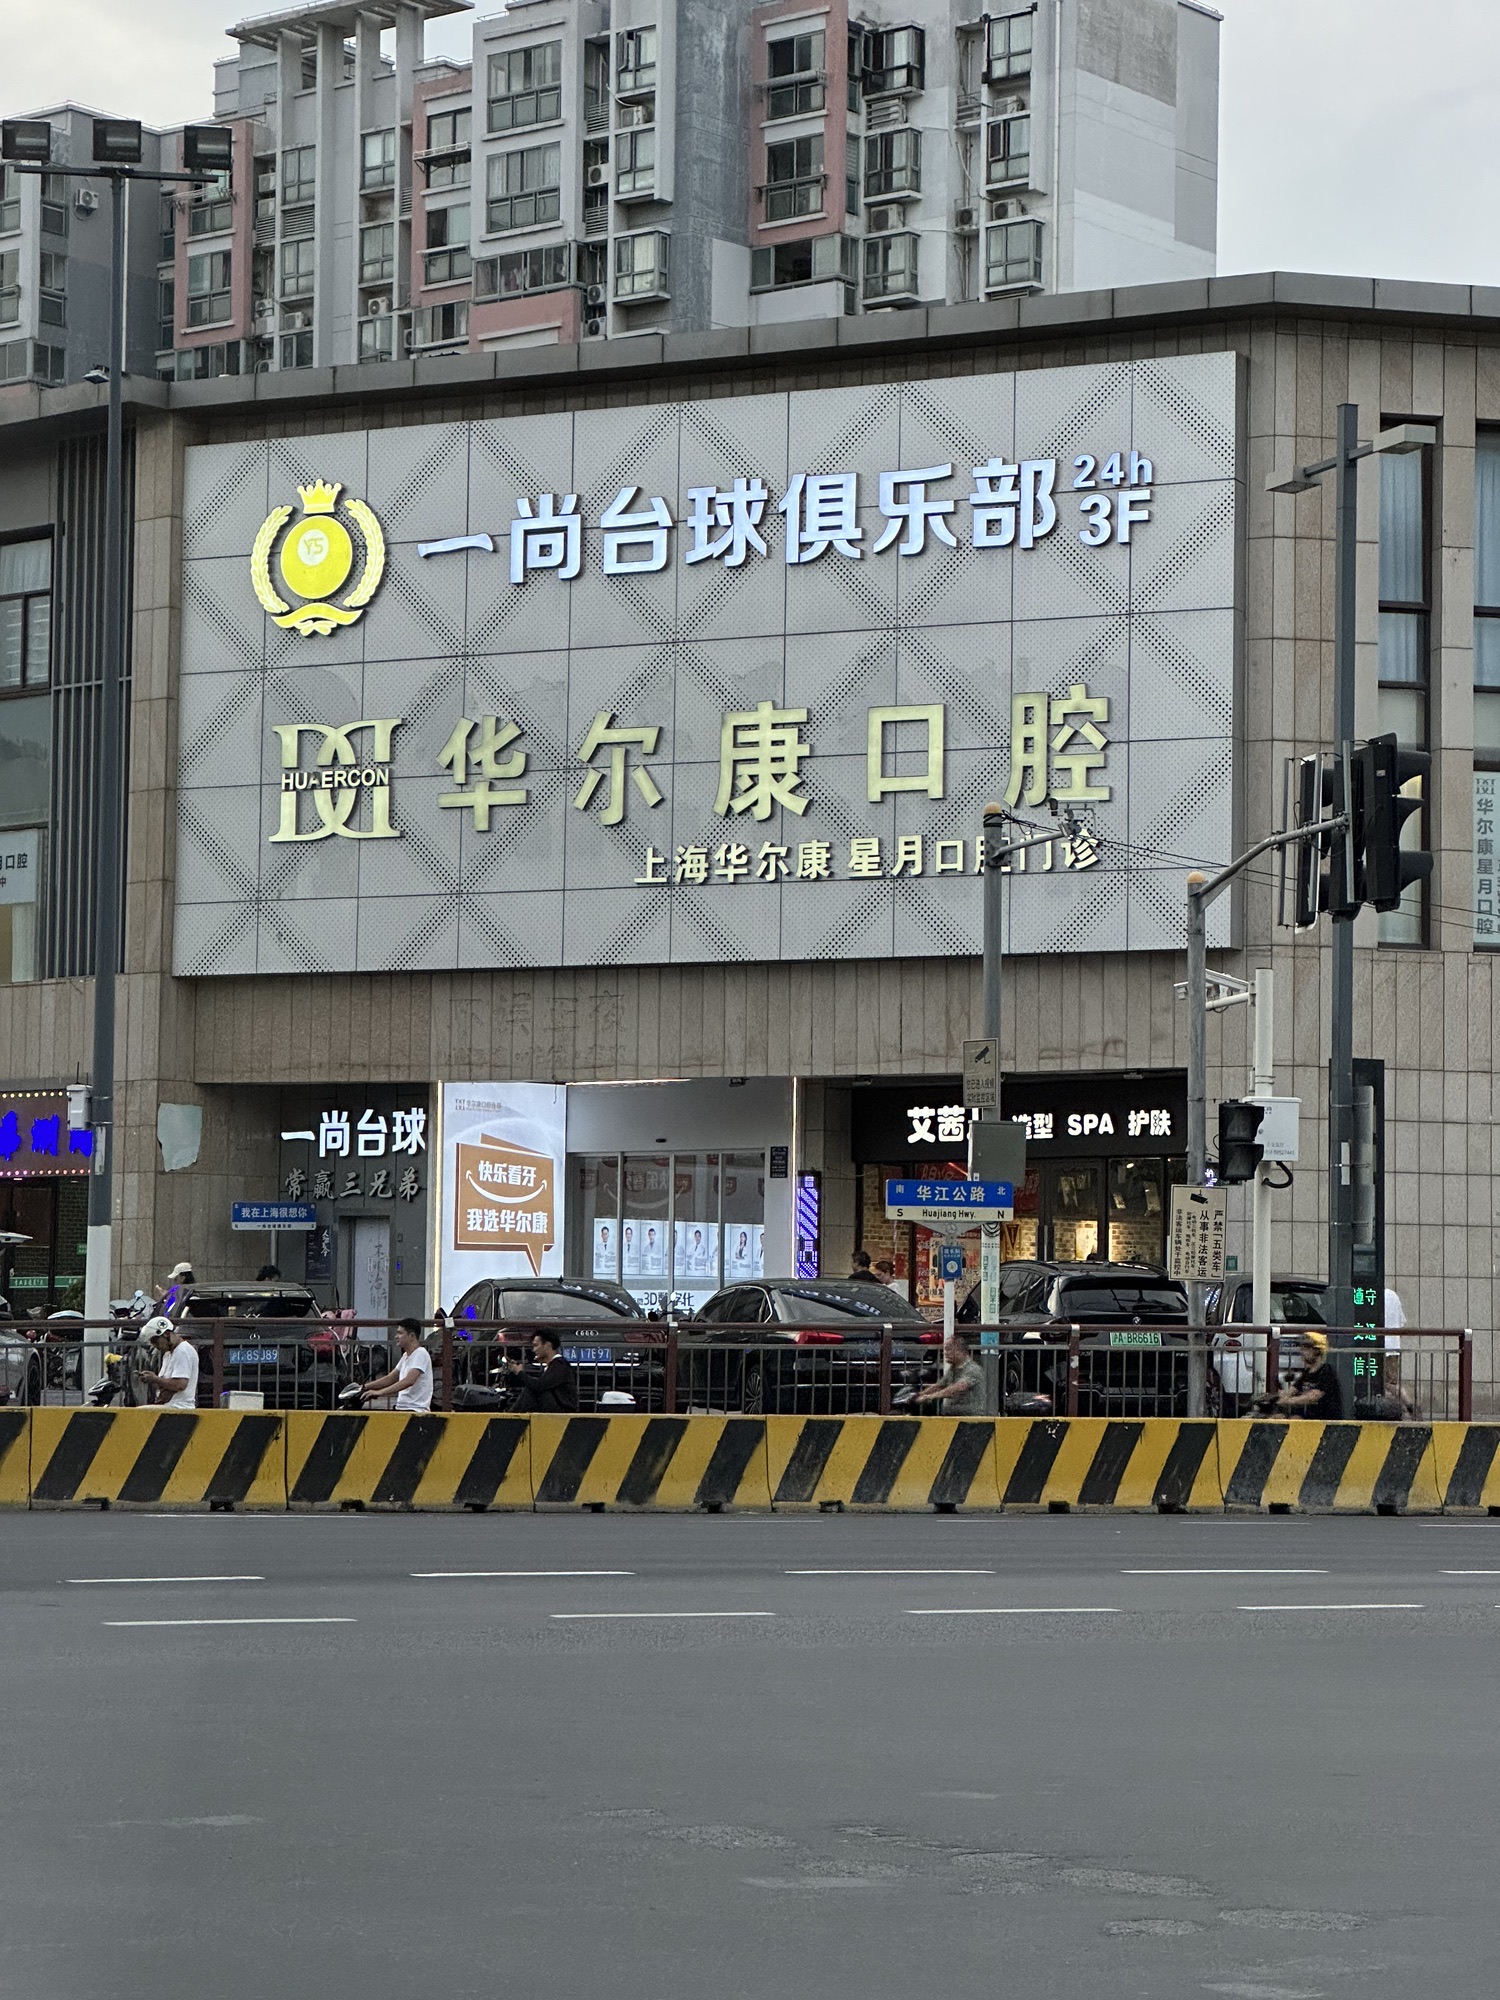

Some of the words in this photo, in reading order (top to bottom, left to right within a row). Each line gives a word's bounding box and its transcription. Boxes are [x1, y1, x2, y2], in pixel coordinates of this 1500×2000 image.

[1072, 450, 1154, 489] 24h
[417, 457, 1057, 585] 一尚台球俱乐部
[1078, 489, 1152, 547] 3F
[436, 683, 1112, 832] 华尔康口腔
[0, 852, 28, 871] 口腔
[1476, 798, 1494, 935] 华尔康星月口腔
[281, 1107, 426, 1158] 一尚台球
[1067, 1113, 1114, 1136] SPA
[1127, 1109, 1171, 1138] 护肤
[284, 1166, 419, 1202] 常赢三兄弟
[478, 1160, 537, 1188] 快乐看牙
[896, 1184, 905, 1194] 南
[917, 1185, 986, 1202] 华江公路
[997, 1186, 1006, 1195] 北
[241, 1207, 308, 1219] 我在上海很想你
[466, 1208, 548, 1234] 我选华尔康
[896, 1208, 904, 1217] S
[922, 1208, 957, 1219] Huajiang
[958, 1209, 976, 1219] Hwy.
[997, 1210, 1005, 1219] N
[1197, 1209, 1210, 1278] 从事非法客运
[1353, 1287, 1377, 1305] 遵守
[1354, 1356, 1378, 1377] 信号
